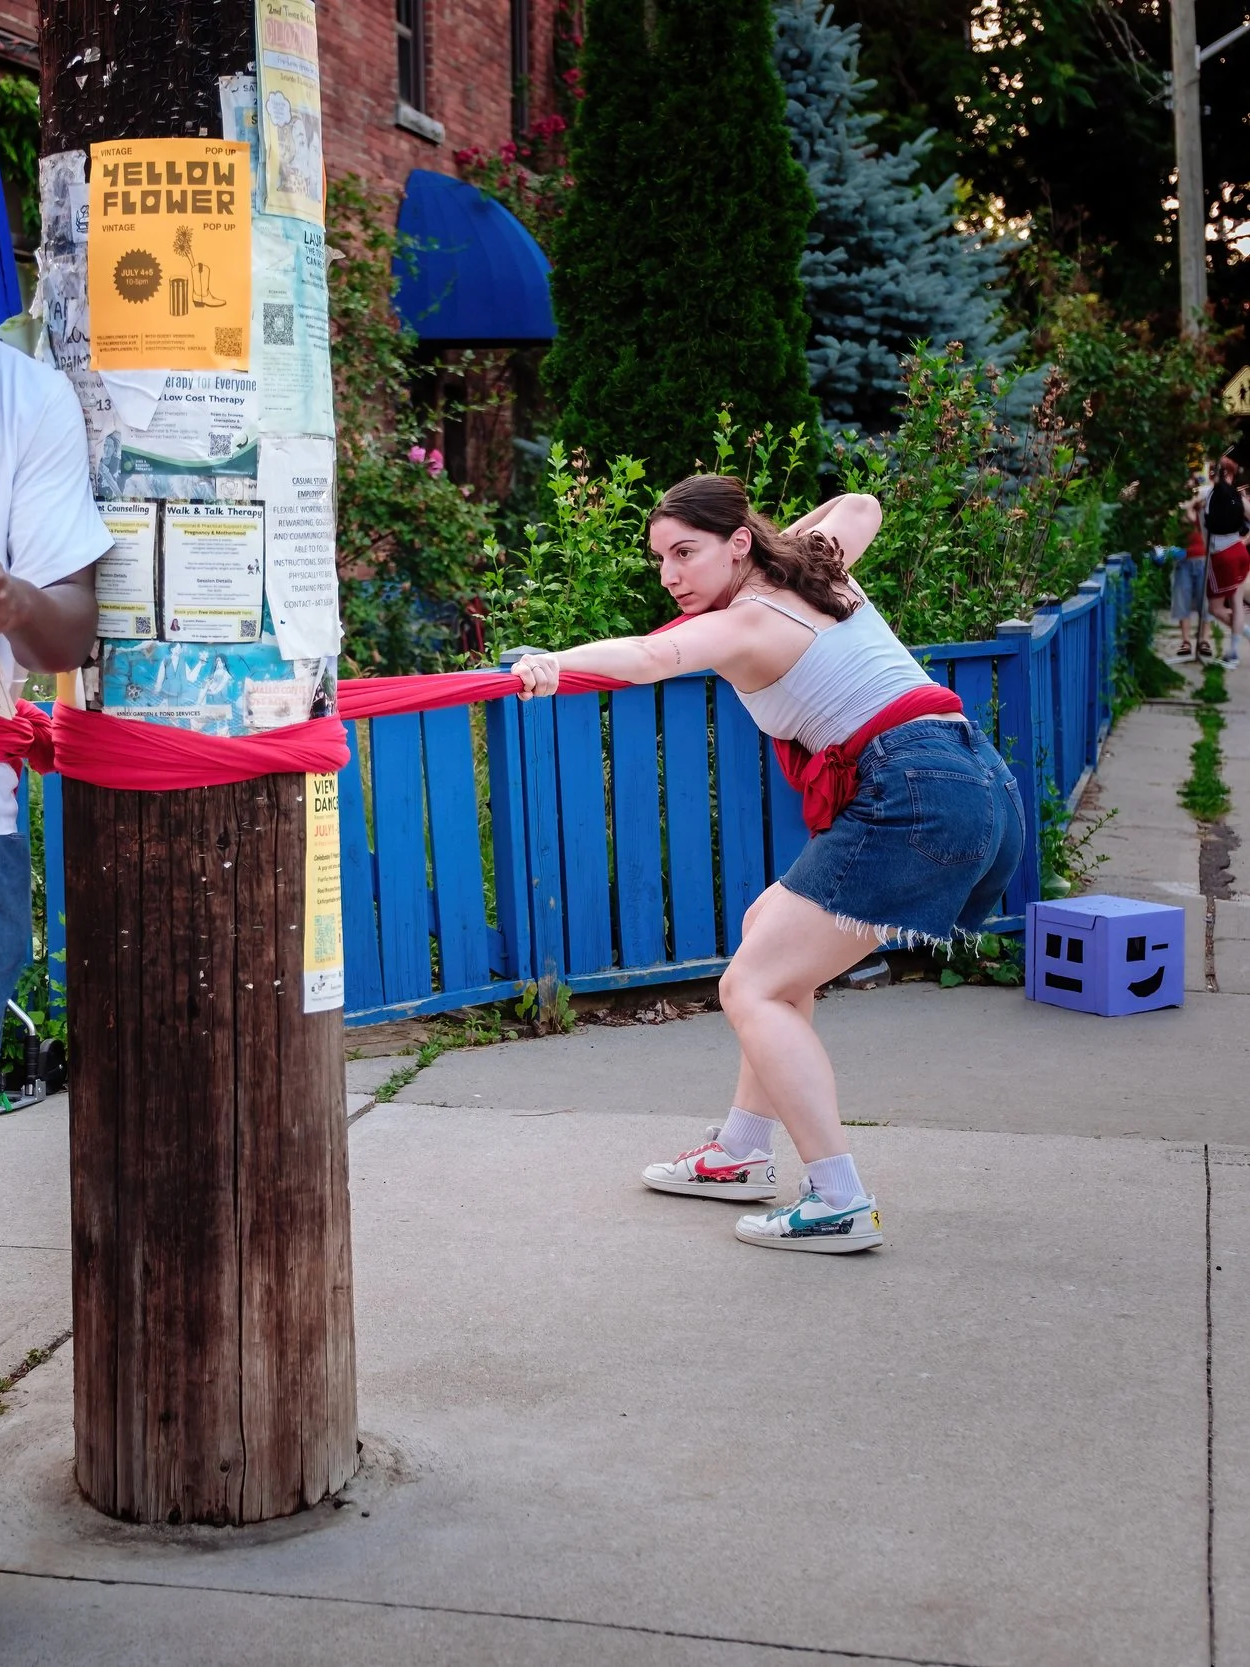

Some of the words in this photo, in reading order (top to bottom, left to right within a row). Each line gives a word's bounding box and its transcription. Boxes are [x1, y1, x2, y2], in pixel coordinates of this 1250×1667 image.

[101, 147, 133, 157] VINTAGE
[205, 146, 223, 155] POP
[225, 148, 236, 156] UP
[103, 161, 235, 187] YELLOW
[103, 190, 235, 216] FLOWER
[102, 224, 135, 232] VINTAGE
[203, 223, 221, 231] POP
[224, 223, 236, 231] UP
[121, 269, 139, 277] JULY
[198, 376, 210, 389] for
[215, 376, 257, 392] Everyone
[164, 393, 182, 402] Low
[186, 394, 206, 402] Cost
[209, 395, 245, 405] Therapy
[97, 399, 111, 411] 13
[292, 477, 313, 485] CASUAL
[107, 505, 149, 515] Counselling
[167, 506, 190, 515] Walk
[194, 507, 201, 515] &
[205, 507, 223, 515] Talk
[228, 508, 262, 518] Therapy
[273, 505, 299, 514] FLEXIBLE
[294, 545, 307, 553] ABLE
[291, 584, 316, 592] TRAINING
[284, 600, 311, 609] CONTACT
[314, 780, 335, 794] VIEW
